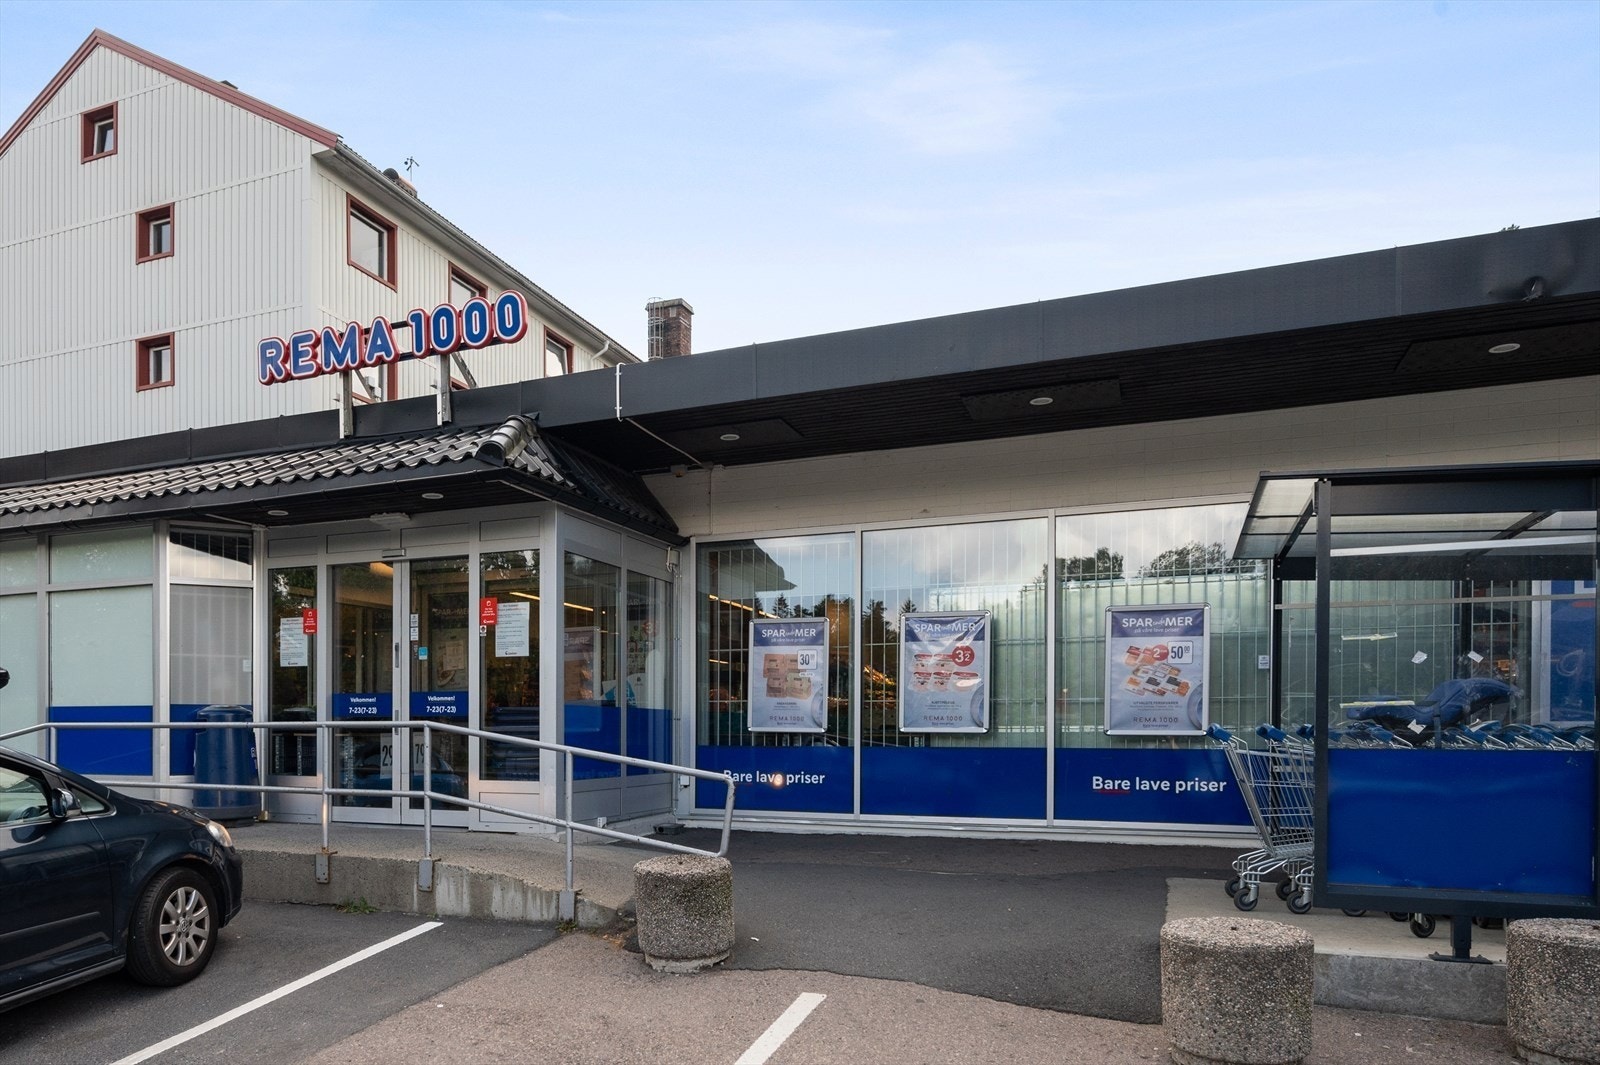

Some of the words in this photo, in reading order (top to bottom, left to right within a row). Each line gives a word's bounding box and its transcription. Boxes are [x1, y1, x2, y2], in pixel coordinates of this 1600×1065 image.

[258, 316, 399, 385] REMA
[407, 290, 528, 358] 1000
[914, 623, 941, 633] SPAR
[951, 622, 976, 632] MER
[1122, 617, 1153, 628] SPAR
[1165, 616, 1193, 627] MER
[761, 629, 786, 638] SPAR
[795, 628, 816, 637] MER
[955, 649, 964, 663] 3
[1153, 647, 1161, 658] 2
[1170, 645, 1184, 660] 50
[799, 653, 810, 666] 30
[426, 705, 457, 714] 7-23(7-23)
[785, 771, 826, 786] priser
[1092, 775, 1131, 790] Bare
[1135, 776, 1171, 791] lave
[1175, 777, 1227, 794] priser
